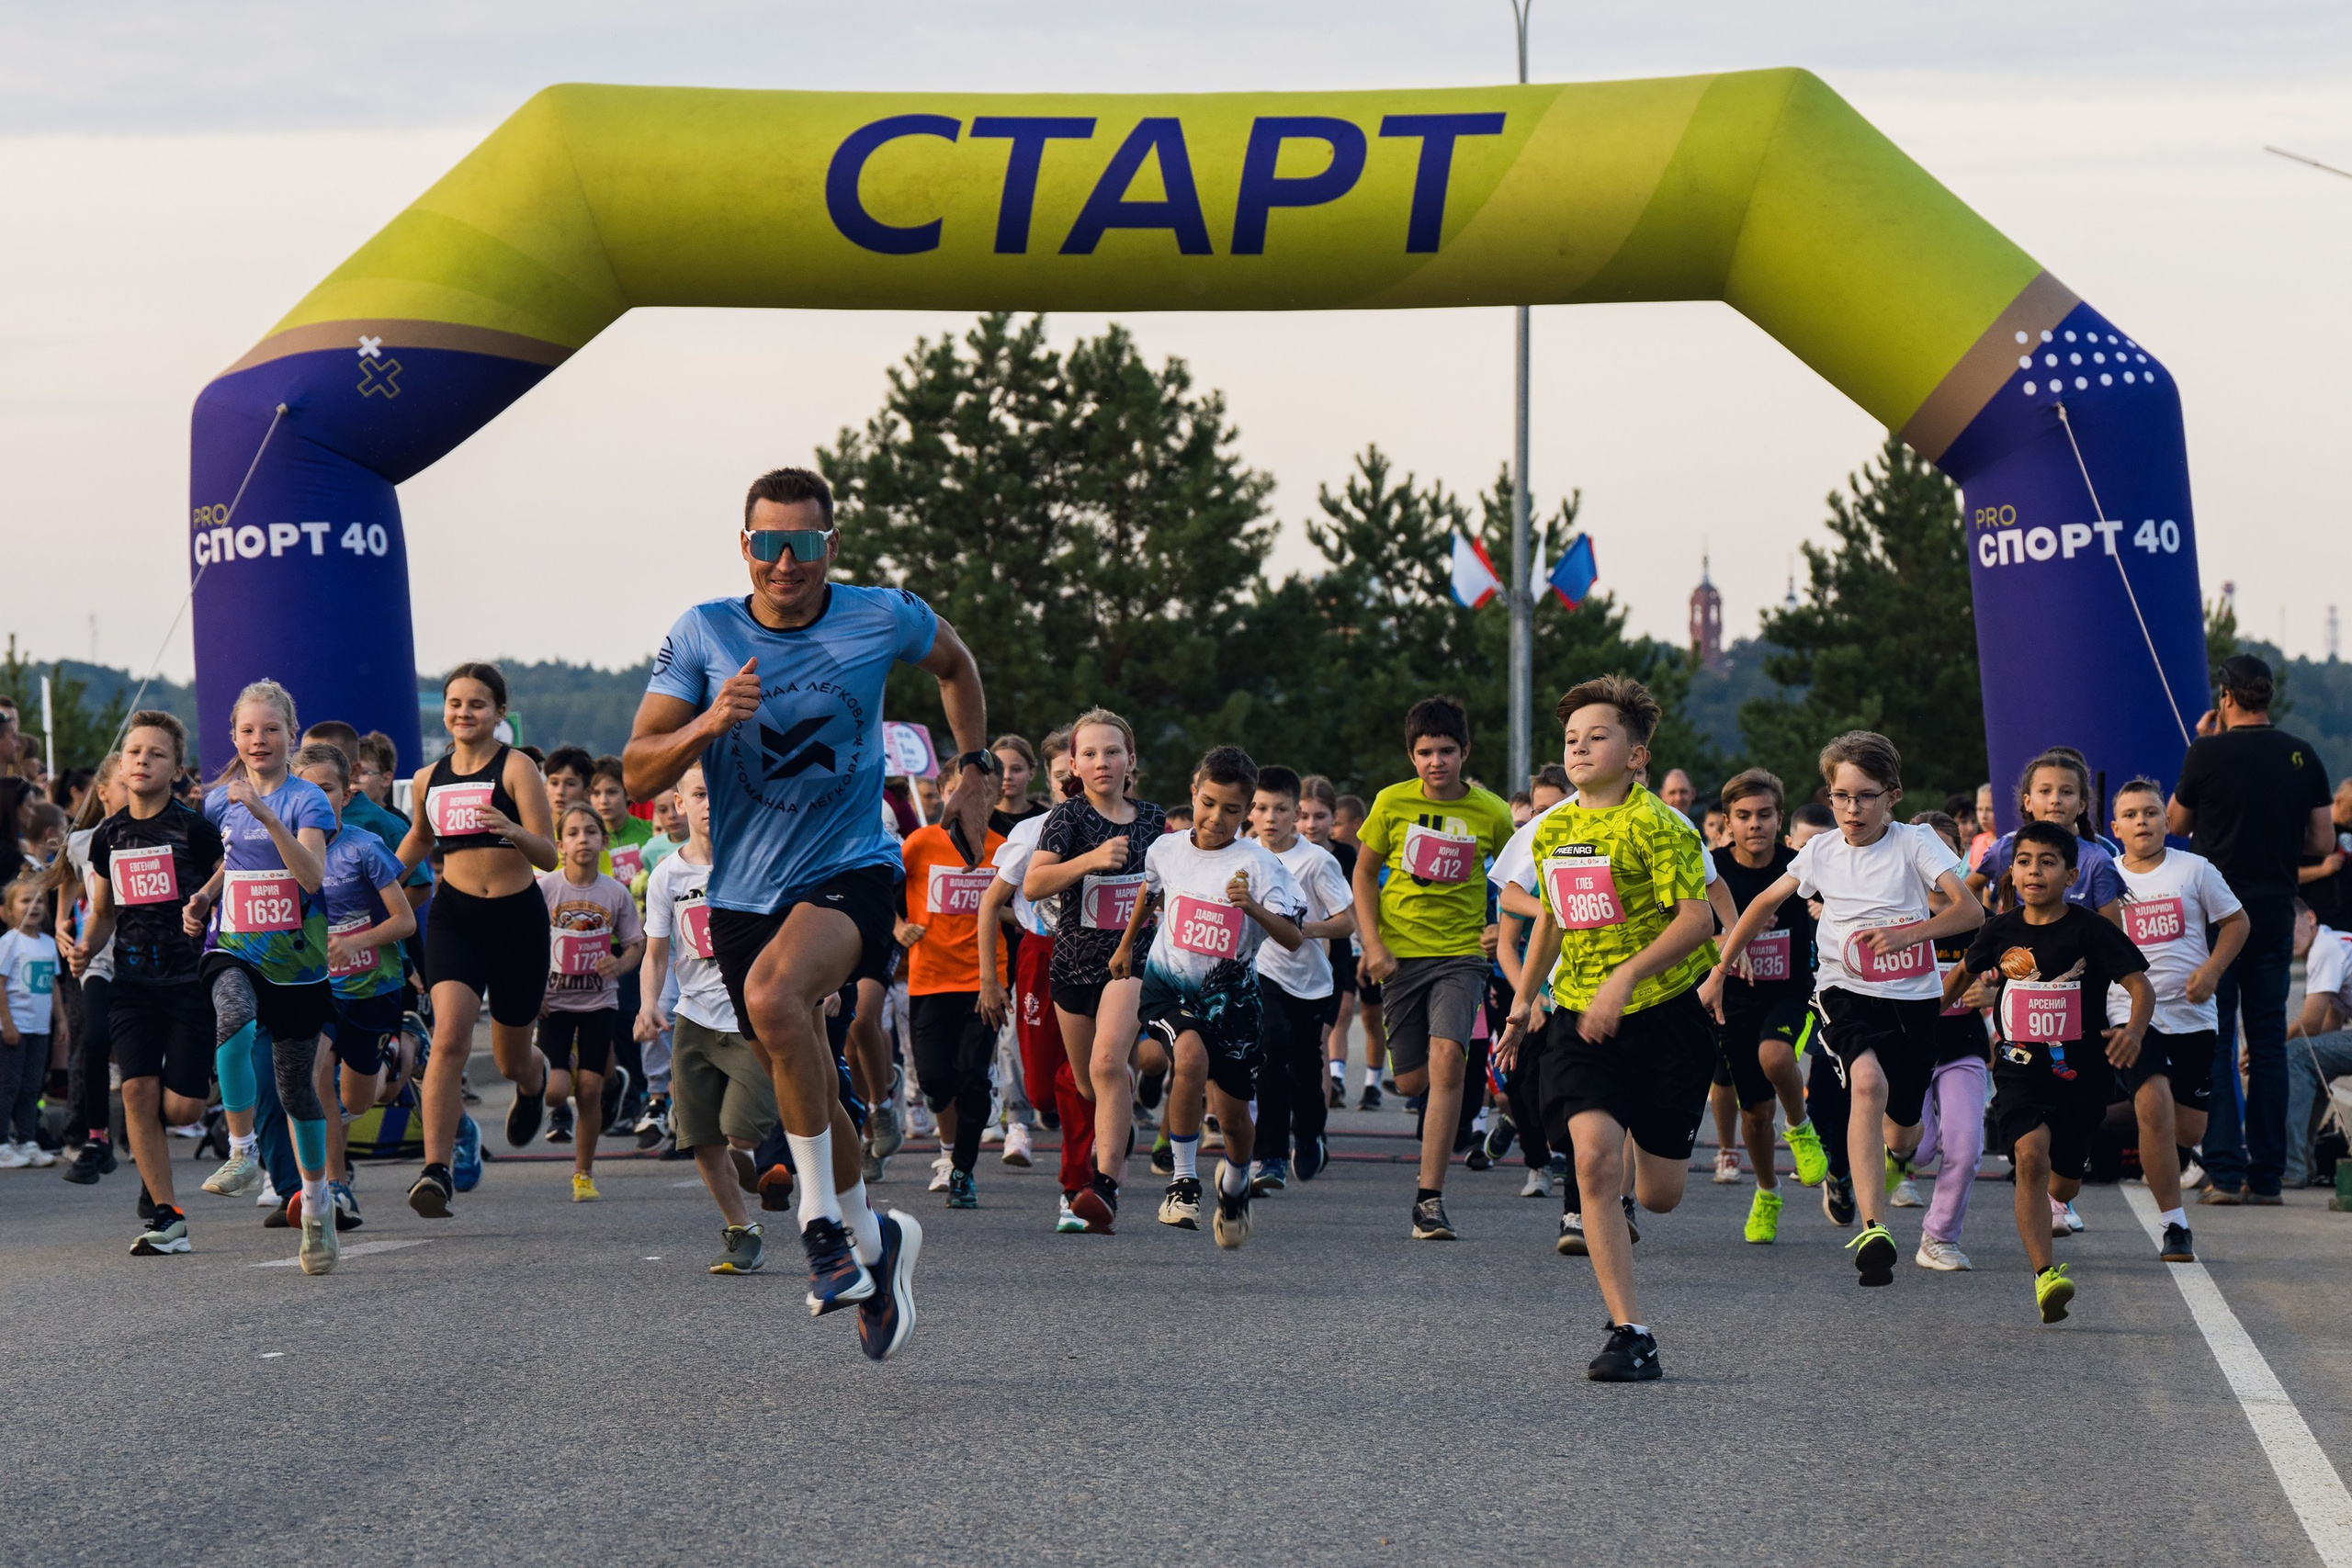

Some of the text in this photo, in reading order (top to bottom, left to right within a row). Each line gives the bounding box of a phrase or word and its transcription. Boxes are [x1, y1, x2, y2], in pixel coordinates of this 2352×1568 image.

[824, 111, 1508, 255] СТАРТ
[193, 503, 229, 528] PRO
[1975, 504, 2017, 529] PRO
[194, 522, 389, 566] СПОРТ 40
[1978, 519, 2180, 568] СПОРТ 40
[449, 795, 482, 807] ВЕРОНИКА
[1438, 846, 1460, 857] ЮРИЙ
[130, 859, 161, 873] ЕВГЕНИЙ
[1429, 857, 1462, 879] 412
[130, 872, 171, 897] 1529
[250, 885, 279, 897] МАРИЯ
[1115, 887, 1140, 898] МАРИН
[1575, 877, 1594, 890] ГЛЕБ
[949, 889, 984, 909] 479
[1567, 892, 1615, 922] 3866
[2134, 902, 2175, 917] ИЛЛАРИОН
[244, 898, 294, 925] 1632
[1193, 908, 1224, 925] ДАВИД
[1182, 919, 1231, 953] 3203
[2135, 914, 2180, 939] 3465
[578, 941, 603, 952] УЛЬЯНА
[1750, 945, 1778, 955] ПЛАТОН
[1872, 942, 1924, 974] 4667
[2028, 997, 2066, 1010] АРСЕНИЙ
[2029, 1012, 2067, 1037] 907
